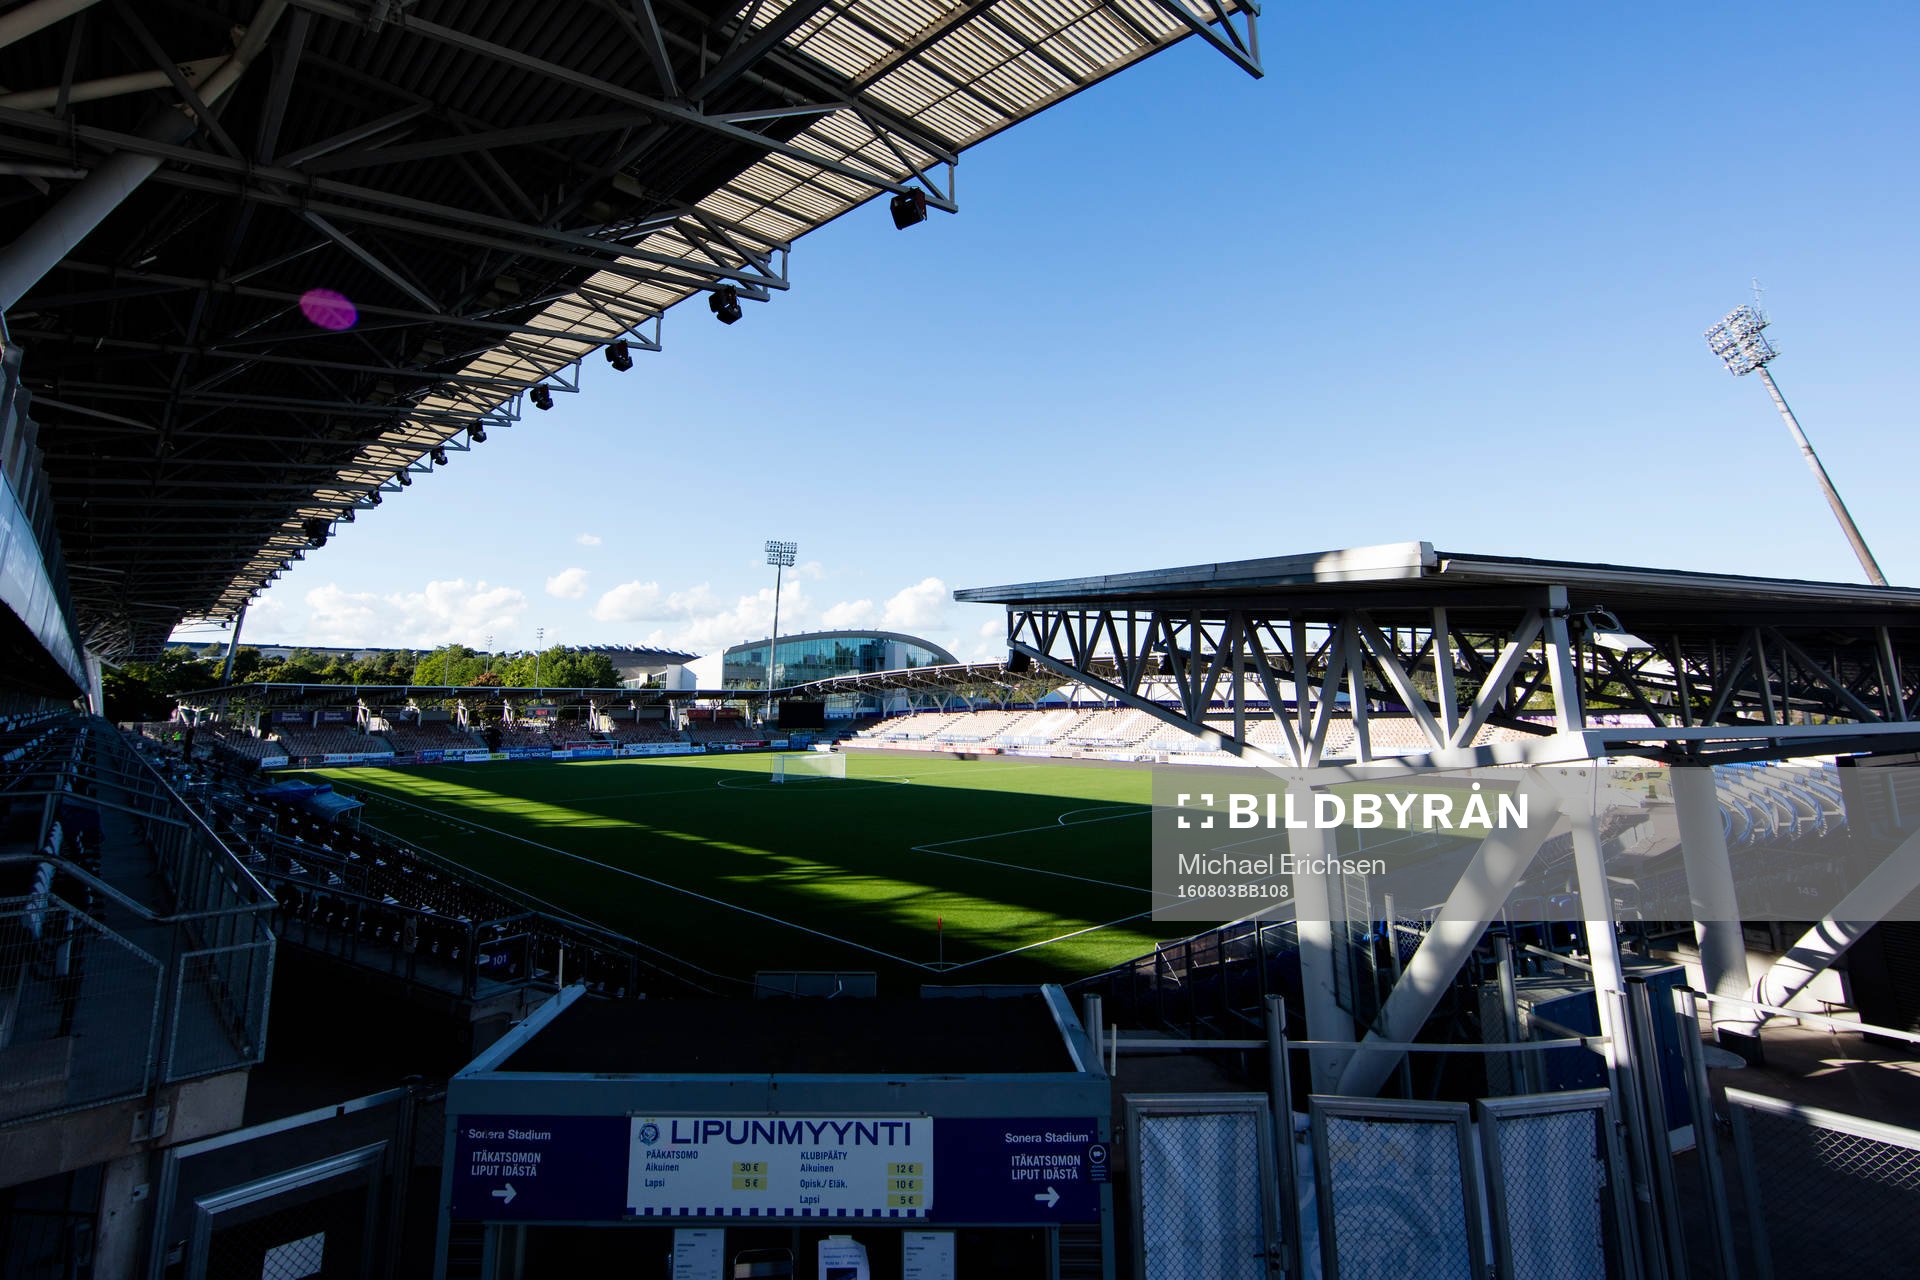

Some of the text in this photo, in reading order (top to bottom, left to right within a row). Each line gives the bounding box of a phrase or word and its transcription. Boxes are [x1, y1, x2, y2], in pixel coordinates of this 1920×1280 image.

[493, 953, 507, 966] 101
[468, 1128, 552, 1141] Sonera Stadium
[671, 1120, 911, 1146] LIPUNMYYNTI
[1005, 1132, 1089, 1143] Sonera Stadium
[472, 1149, 542, 1164] ITÄKATSOMON
[646, 1149, 699, 1160] PÄÄKATSOMO
[800, 1150, 848, 1160] KLUBIPÄÄTY
[1011, 1153, 1081, 1167] ITÄKATSOMON
[471, 1164, 537, 1177] LIPUT IDÄSTÄ
[645, 1162, 679, 1172] Aikuinen
[740, 1163, 759, 1172] 30 €
[800, 1163, 834, 1173] Aikuinen
[896, 1164, 914, 1173] 12 €
[1011, 1168, 1041, 1180] LIPUT
[1043, 1167, 1079, 1180] IDÄSTÄ
[645, 1178, 665, 1188] Lapsi
[744, 1179, 759, 1188] 5 €
[896, 1179, 914, 1189] 10 €
[799, 1195, 820, 1205] Lapsi
[899, 1196, 914, 1205] 5 €
